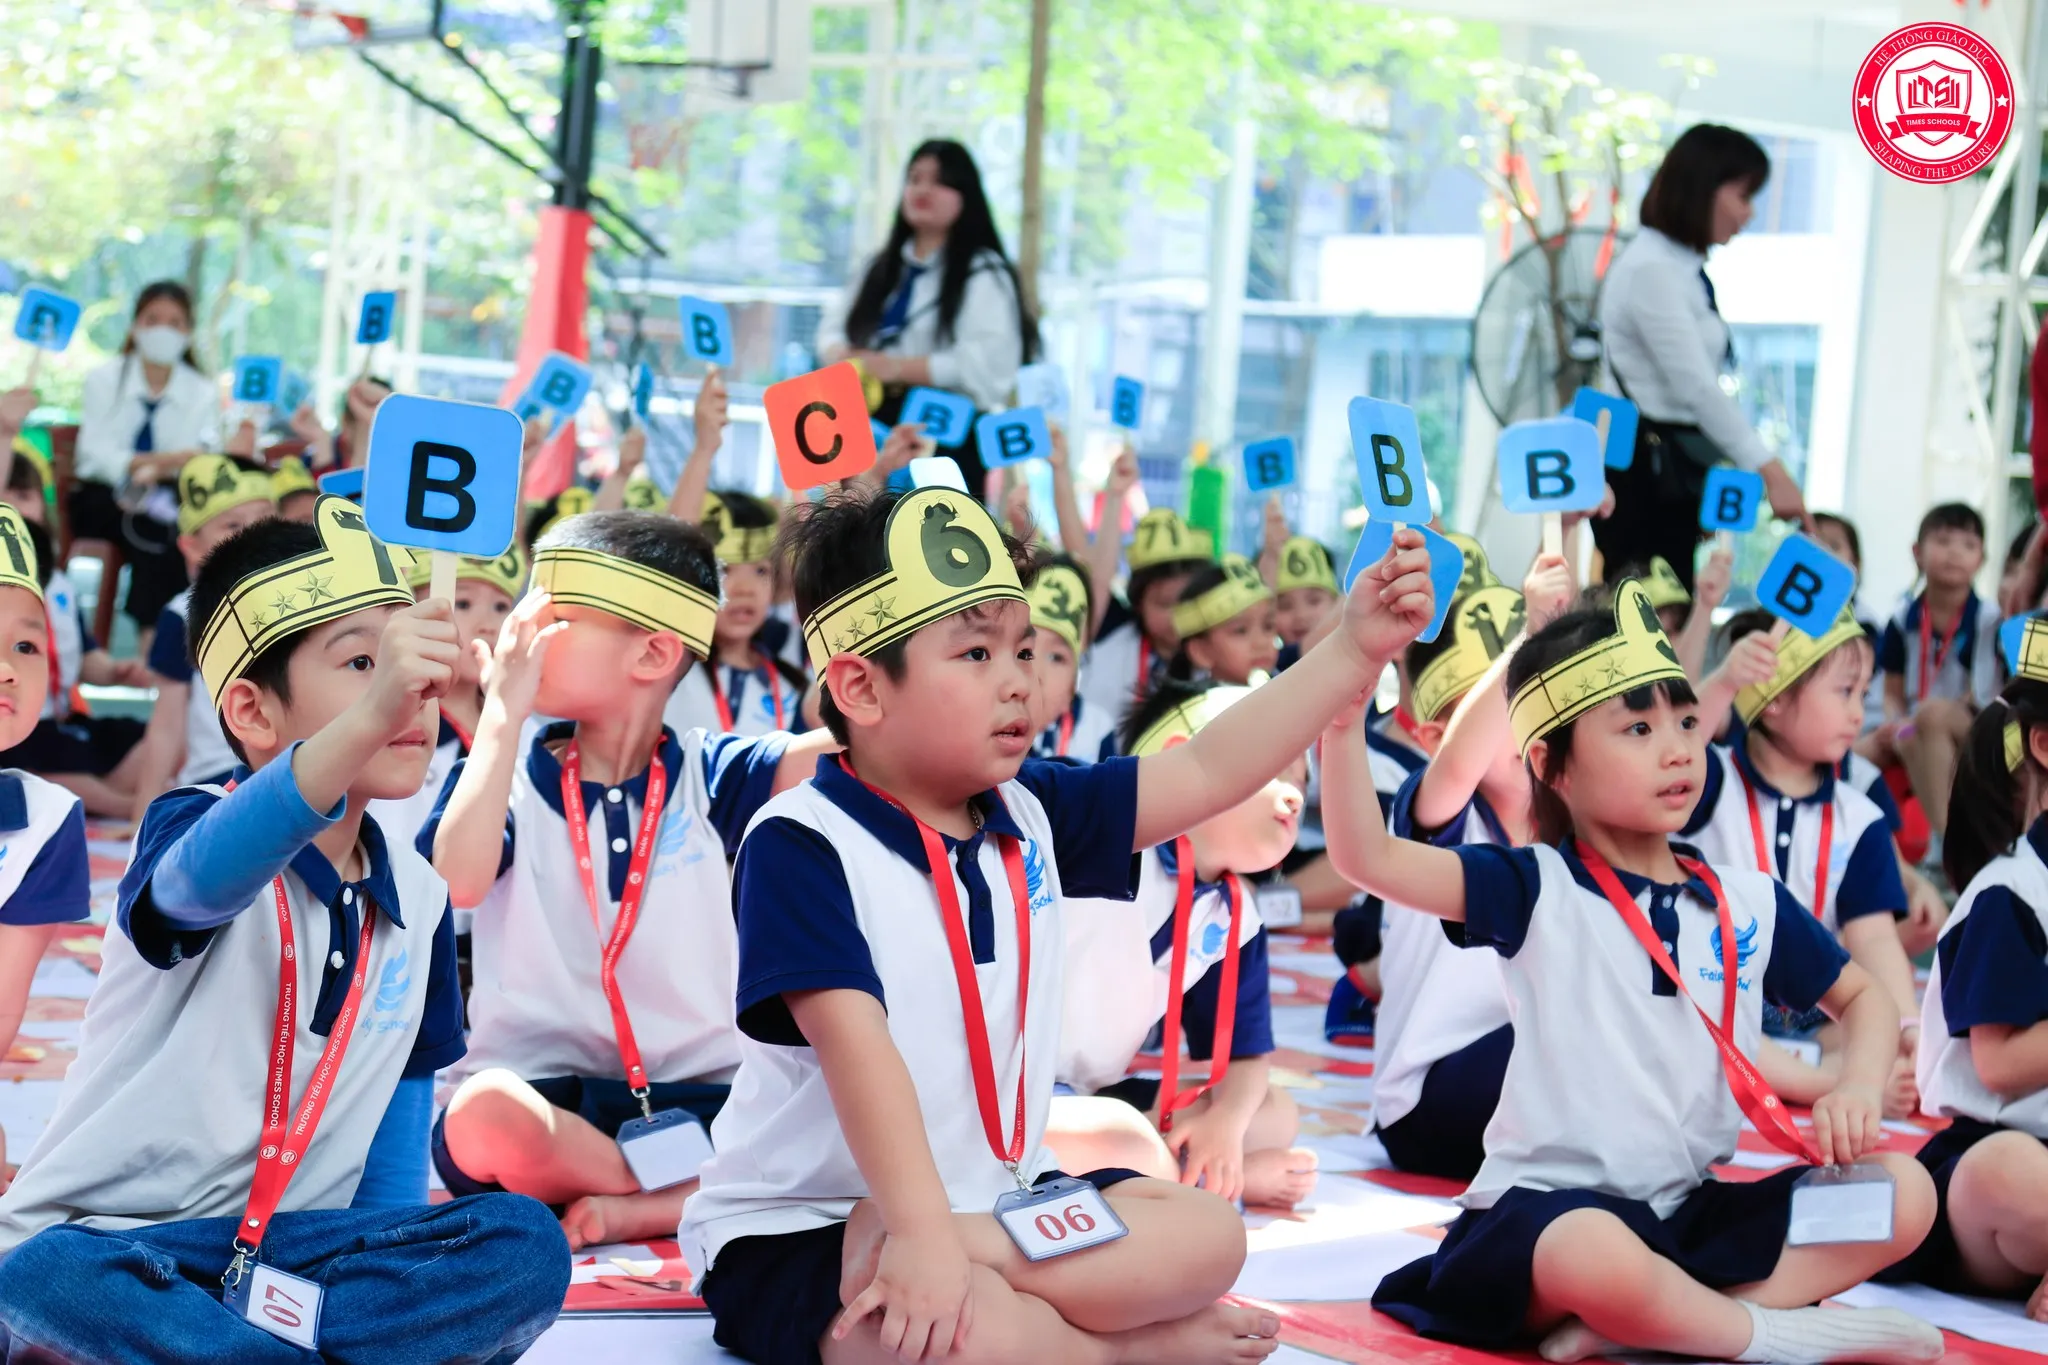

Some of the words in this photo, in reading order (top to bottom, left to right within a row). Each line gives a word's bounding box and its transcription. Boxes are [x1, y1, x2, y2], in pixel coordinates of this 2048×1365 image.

[363, 304, 385, 340] B
[692, 311, 721, 356] B
[242, 365, 271, 400] B
[541, 368, 577, 406] B
[918, 402, 953, 436] B
[1116, 388, 1137, 425] B
[795, 401, 843, 464] C
[996, 422, 1035, 459] B
[405, 440, 478, 533] B
[1257, 451, 1285, 486] B
[1371, 433, 1413, 507] B
[1526, 449, 1575, 500] B
[1717, 486, 1744, 523] B
[918, 501, 991, 587] 6
[1775, 562, 1823, 616] B
[327, 1039, 341, 1063] TIMES
[336, 1007, 352, 1039] SCHOOL
[276, 1044, 287, 1065] HỌC
[273, 1066, 284, 1092] TIMES
[269, 1094, 281, 1131] SCHOOL
[1034, 1203, 1096, 1241] 06
[262, 1284, 303, 1328] 07
